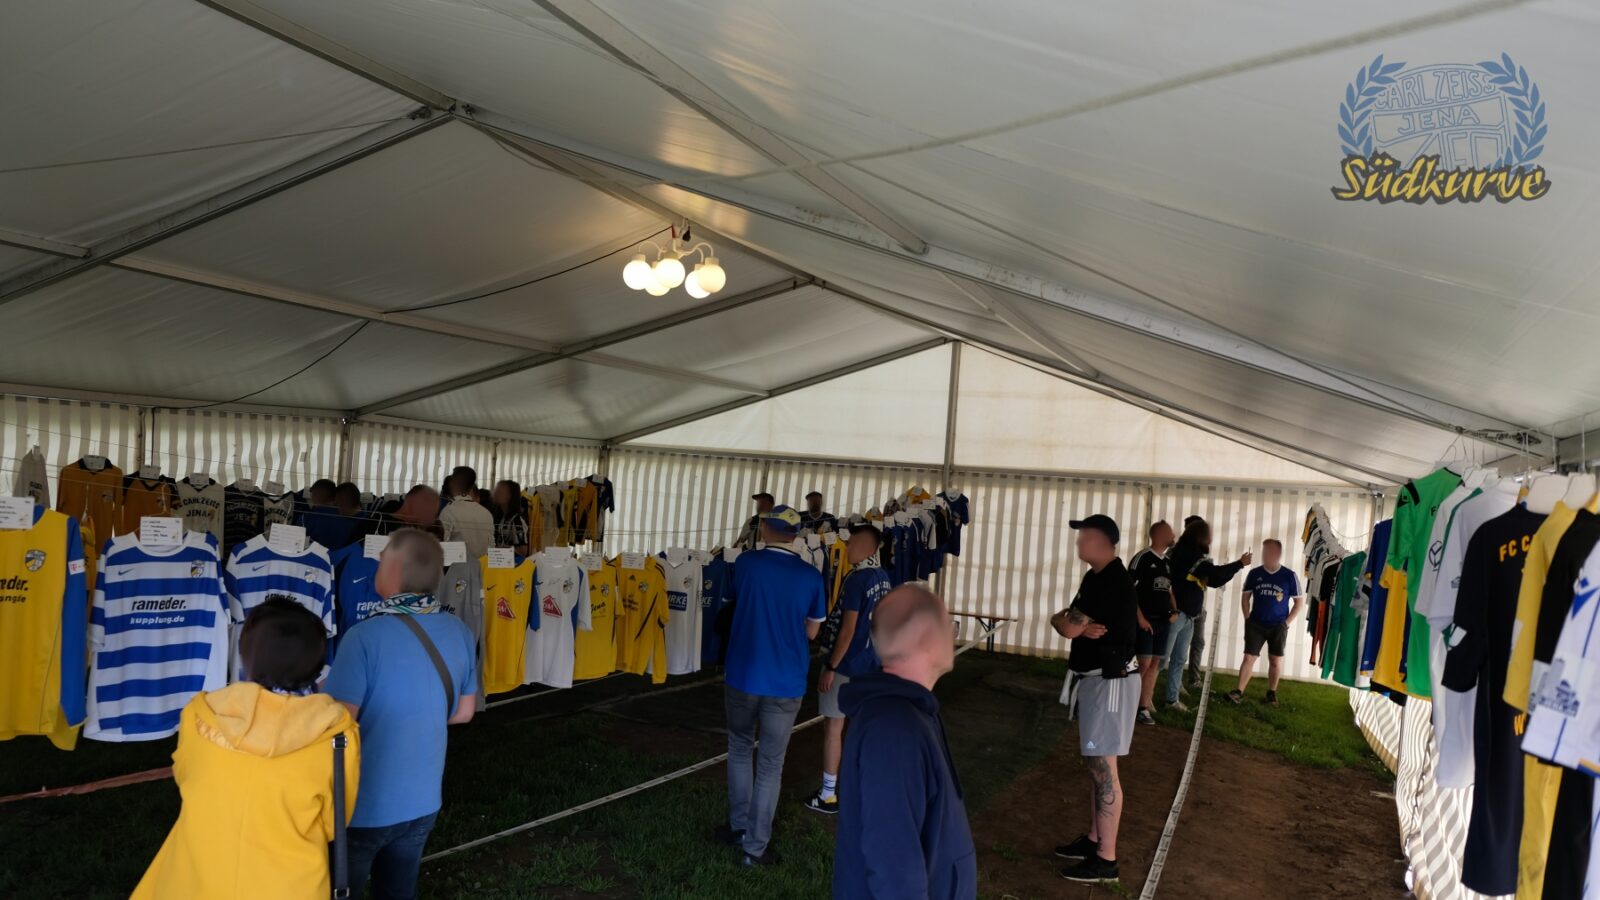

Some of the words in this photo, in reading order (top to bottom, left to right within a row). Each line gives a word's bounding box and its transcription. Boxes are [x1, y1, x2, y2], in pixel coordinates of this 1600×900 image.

[186, 509, 207, 518] JENA
[1499, 540, 1517, 562] FC
[131, 597, 187, 611] rameder.
[130, 615, 185, 625] kupplung.de
